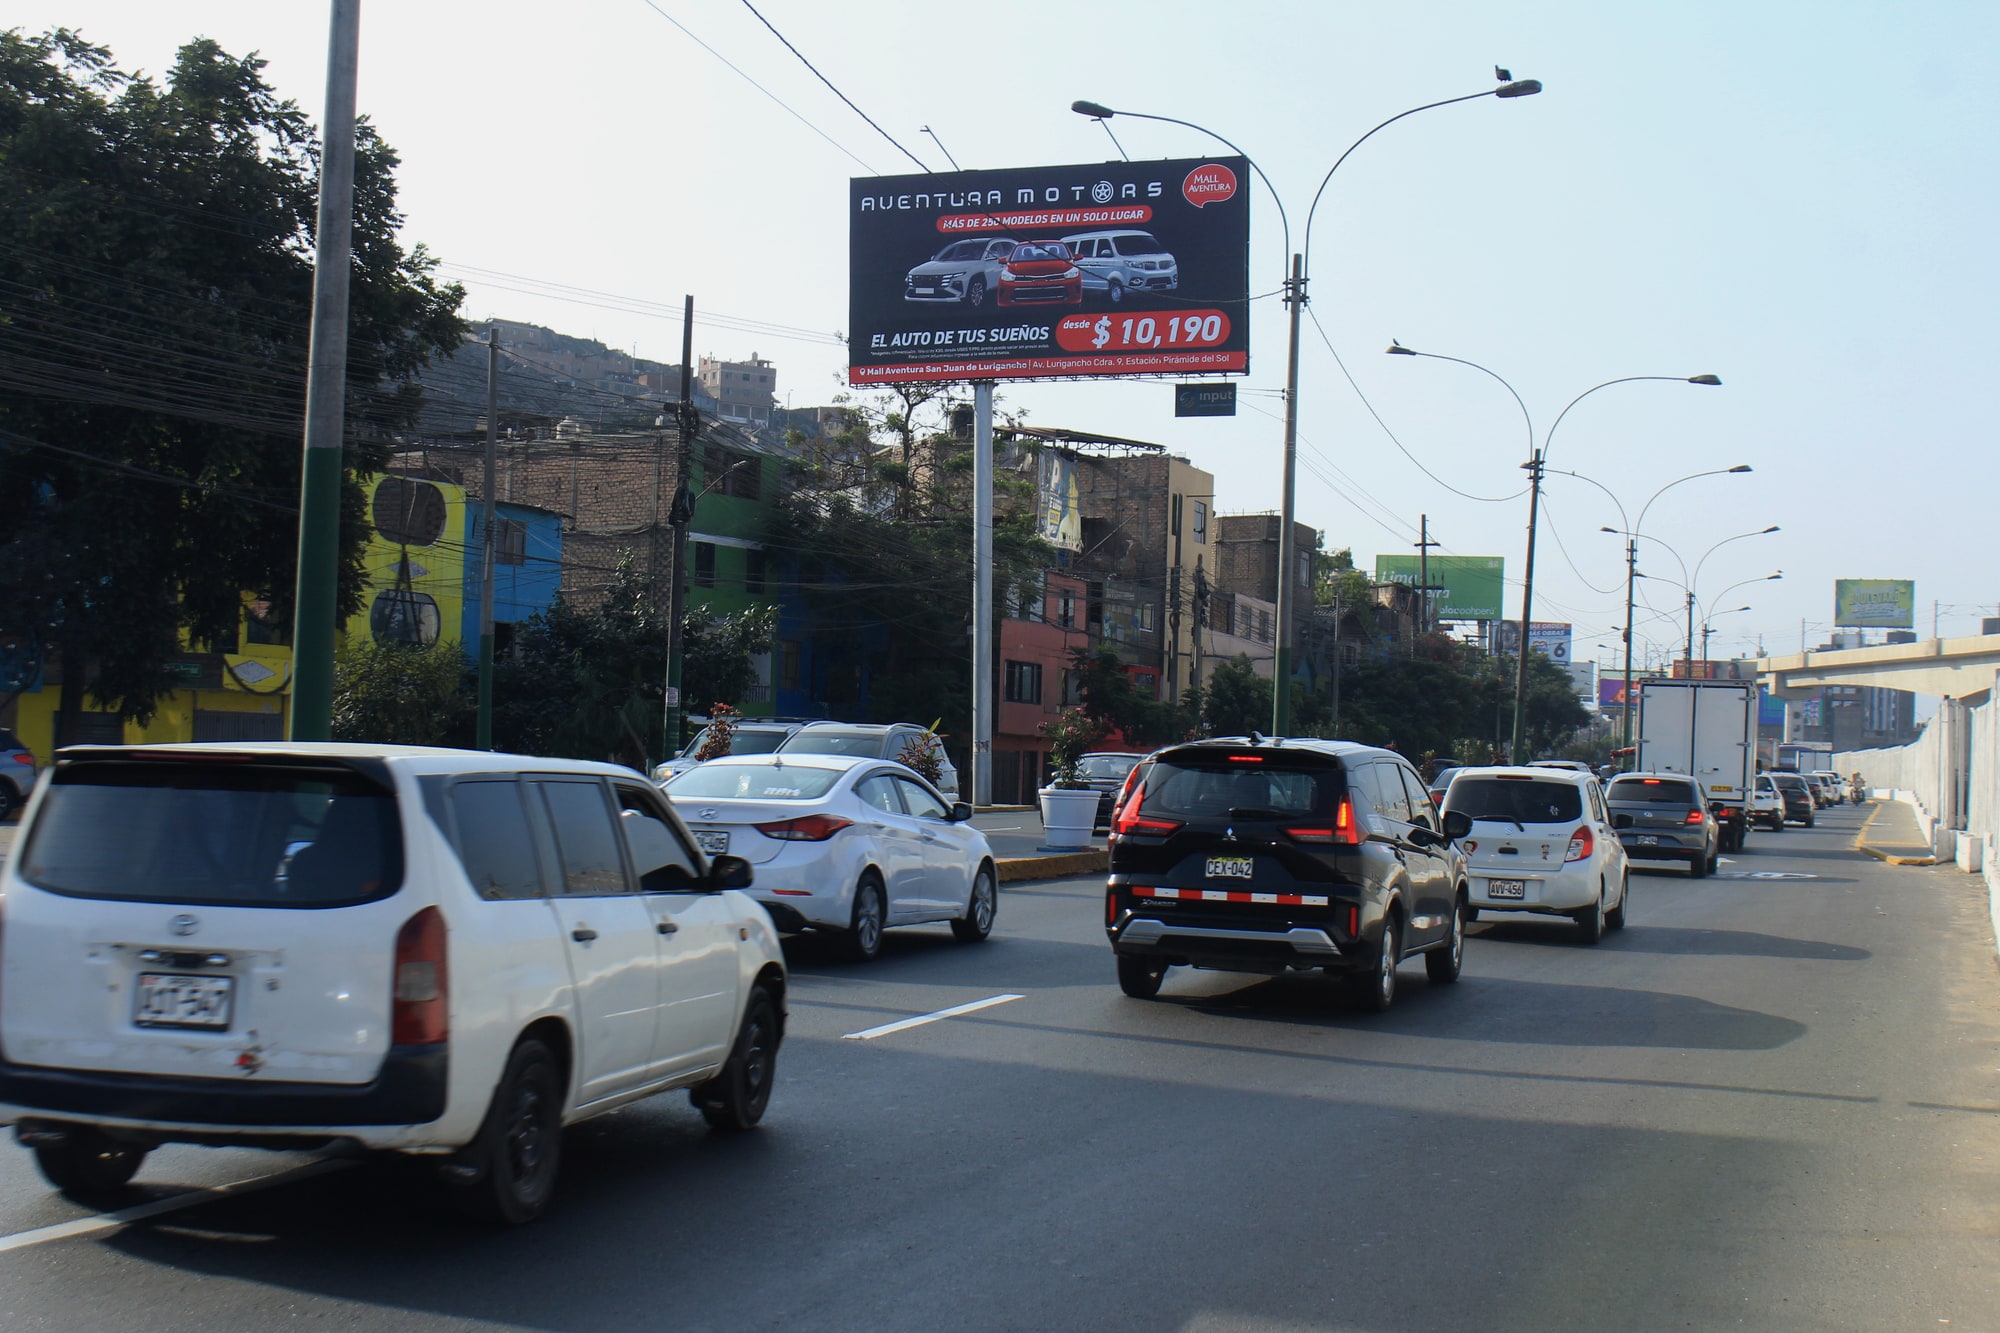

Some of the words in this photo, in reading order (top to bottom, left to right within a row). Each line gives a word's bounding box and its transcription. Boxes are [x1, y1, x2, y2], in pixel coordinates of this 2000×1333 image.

[1193, 174, 1219, 184] MALL
[1188, 183, 1231, 193] AVENTURA
[861, 190, 1001, 212] AVENTURA
[967, 218, 980, 227] DE
[1003, 214, 1048, 225] MODELOS
[1050, 213, 1064, 223] EN
[1066, 212, 1081, 222] UN
[1083, 211, 1108, 221] SOLO
[1110, 209, 1144, 220] LUGAR
[1063, 320, 1091, 329] desde
[1092, 315, 1112, 349] $
[1121, 315, 1221, 348] 10,190
[871, 334, 888, 348] EL
[890, 332, 930, 348] AUTO
[933, 331, 955, 345] DE
[957, 329, 986, 344] TUS
[988, 324, 1050, 342] SUEÑOS
[867, 367, 884, 376] Mall
[885, 366, 924, 375] Aventura
[925, 365, 942, 374] San
[943, 364, 965, 373] Juan
[966, 363, 977, 371] de
[1046, 359, 1092, 370] Lurigancho
[1163, 354, 1200, 364] Pirámide
[1201, 354, 1215, 363] del
[1216, 353, 1230, 363] Sol
[1553, 642, 1566, 658] 6
[1207, 860, 1251, 876] CEX-042
[1489, 882, 1523, 896] AVV-456
